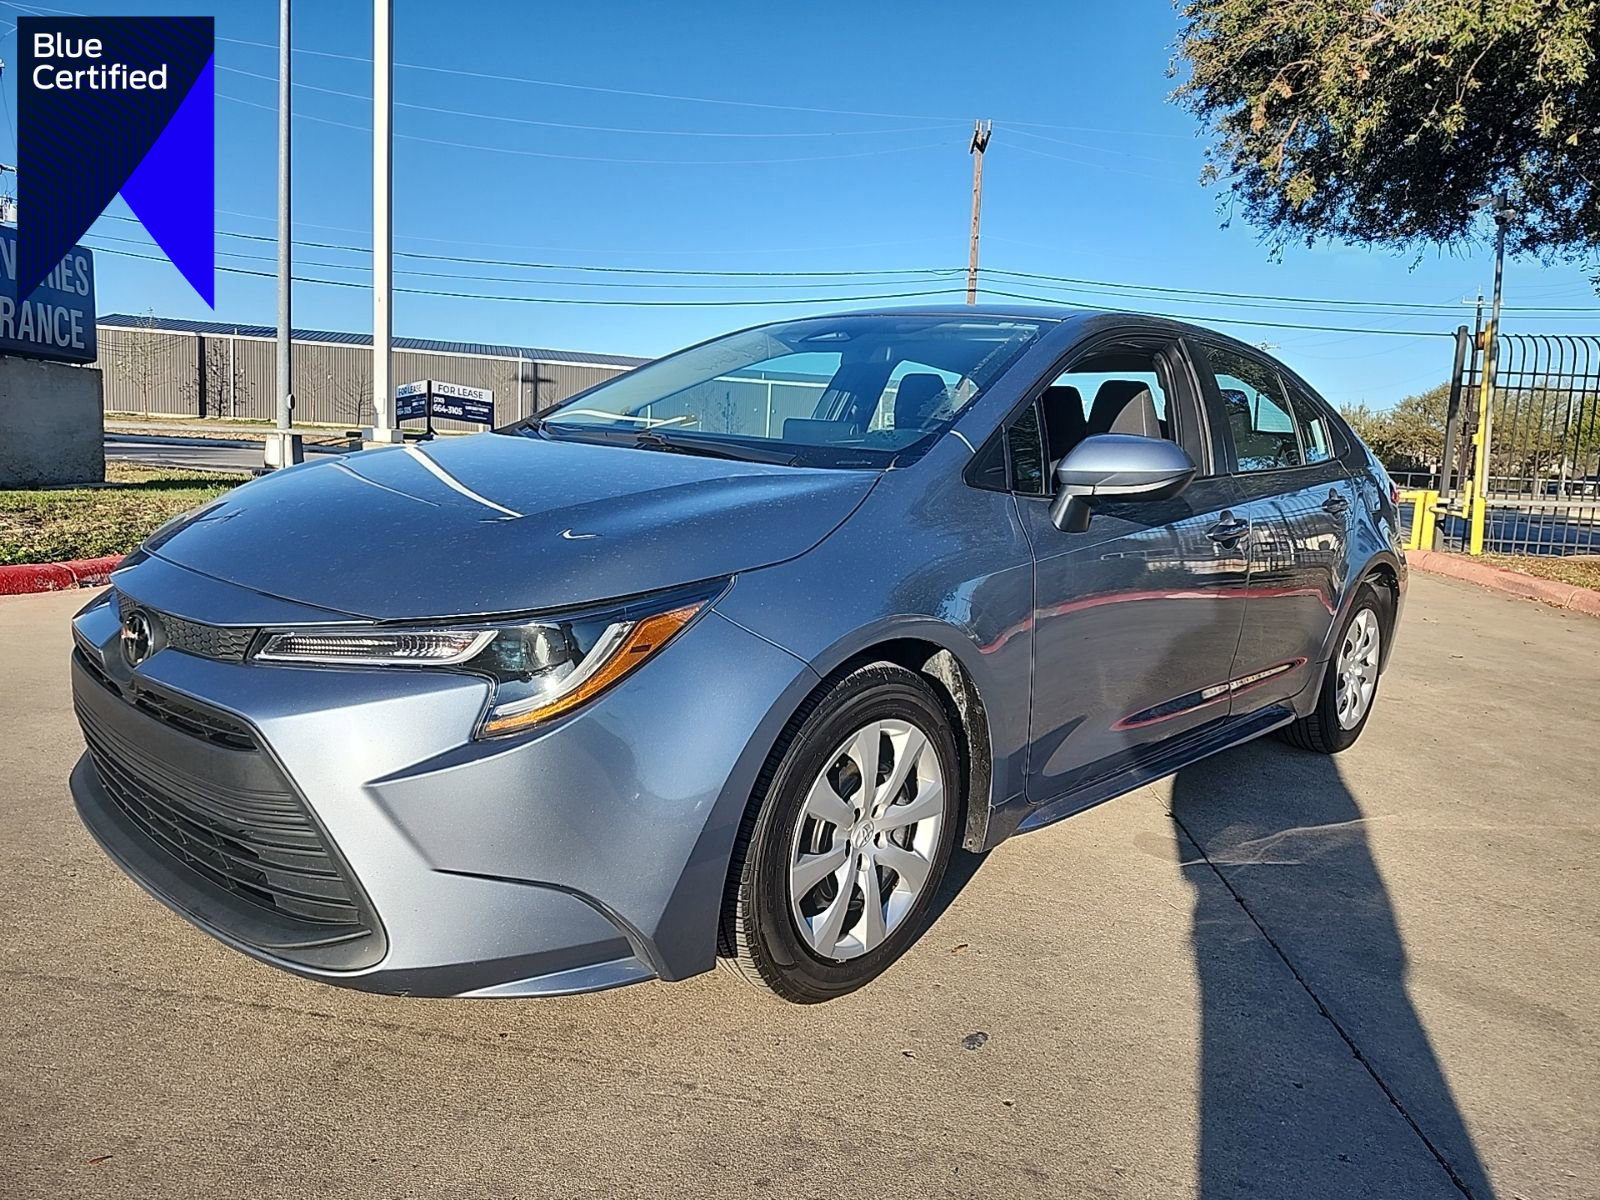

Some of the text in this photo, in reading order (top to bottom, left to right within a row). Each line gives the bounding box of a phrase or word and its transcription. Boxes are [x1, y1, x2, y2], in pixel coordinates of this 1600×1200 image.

[0, 295, 86, 350] RANCE
[438, 384, 456, 395] FOR
[457, 387, 484, 400] LEASE
